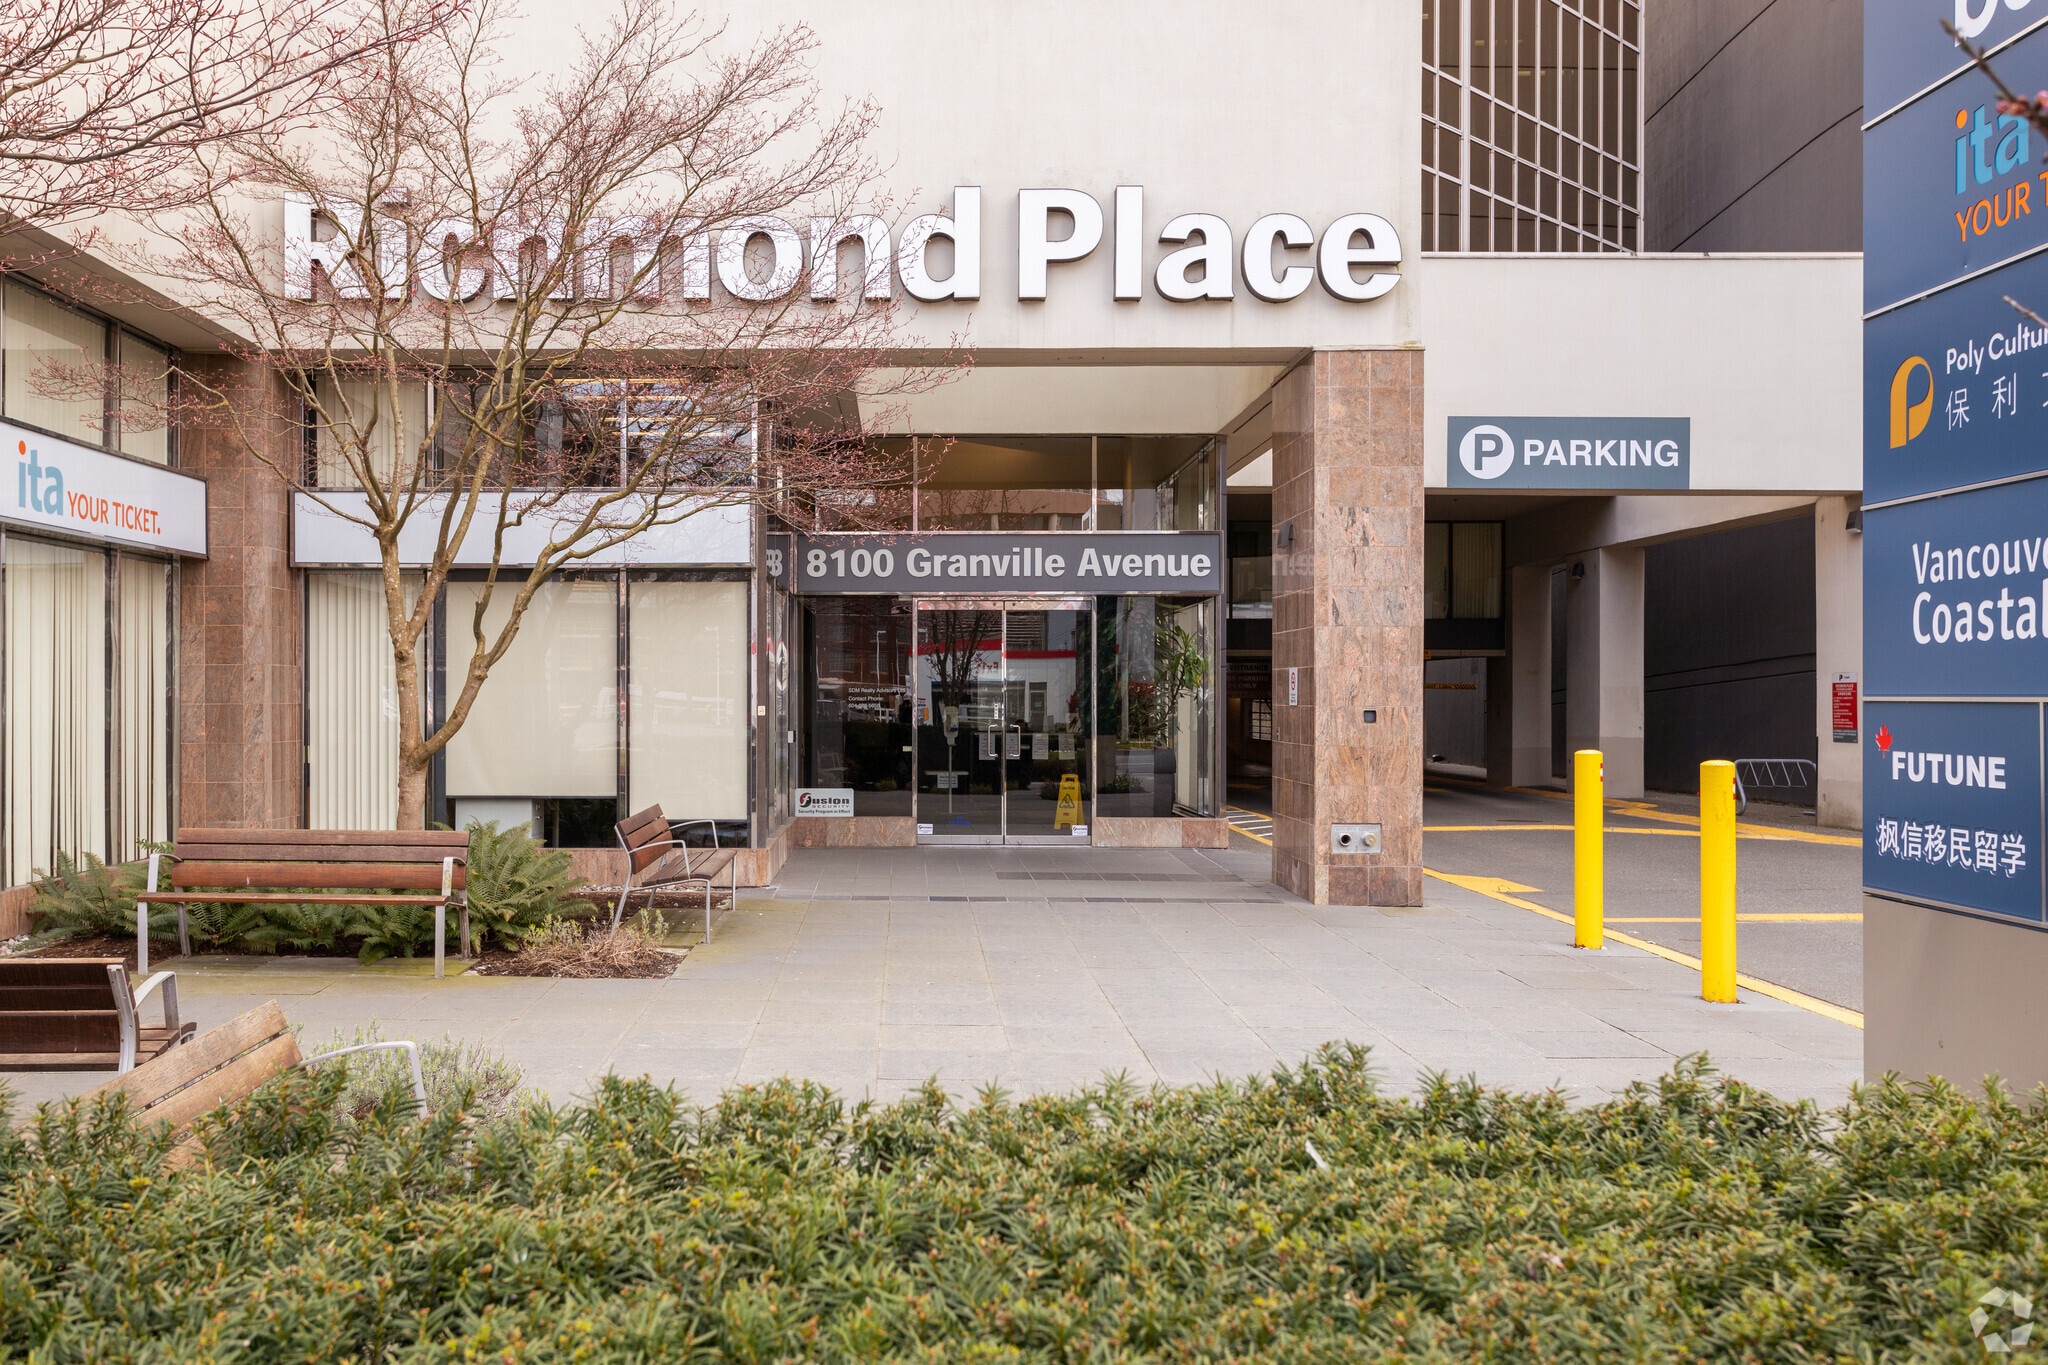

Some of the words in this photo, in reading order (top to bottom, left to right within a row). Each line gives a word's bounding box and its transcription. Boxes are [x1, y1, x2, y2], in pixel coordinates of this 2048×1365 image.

[1955, 104, 2029, 195] ita
[1954, 181, 2031, 242] YOUR
[282, 186, 981, 303] Richmond
[1018, 186, 1402, 303] Place
[1946, 339, 1984, 375] Poly
[1945, 371, 2048, 431] 保利
[1523, 439, 1679, 467] PARKING
[18, 440, 64, 516] ita
[67, 491, 109, 524] YOUR
[112, 502, 161, 535] TICKET.
[806, 549, 894, 578] 8100
[906, 548, 1065, 578] Granville
[1077, 548, 1211, 578] Avenue
[1913, 578, 2048, 645] Coastal
[1892, 751, 2006, 790] FUTUNE
[1877, 817, 2026, 875] 枫信移民留学
